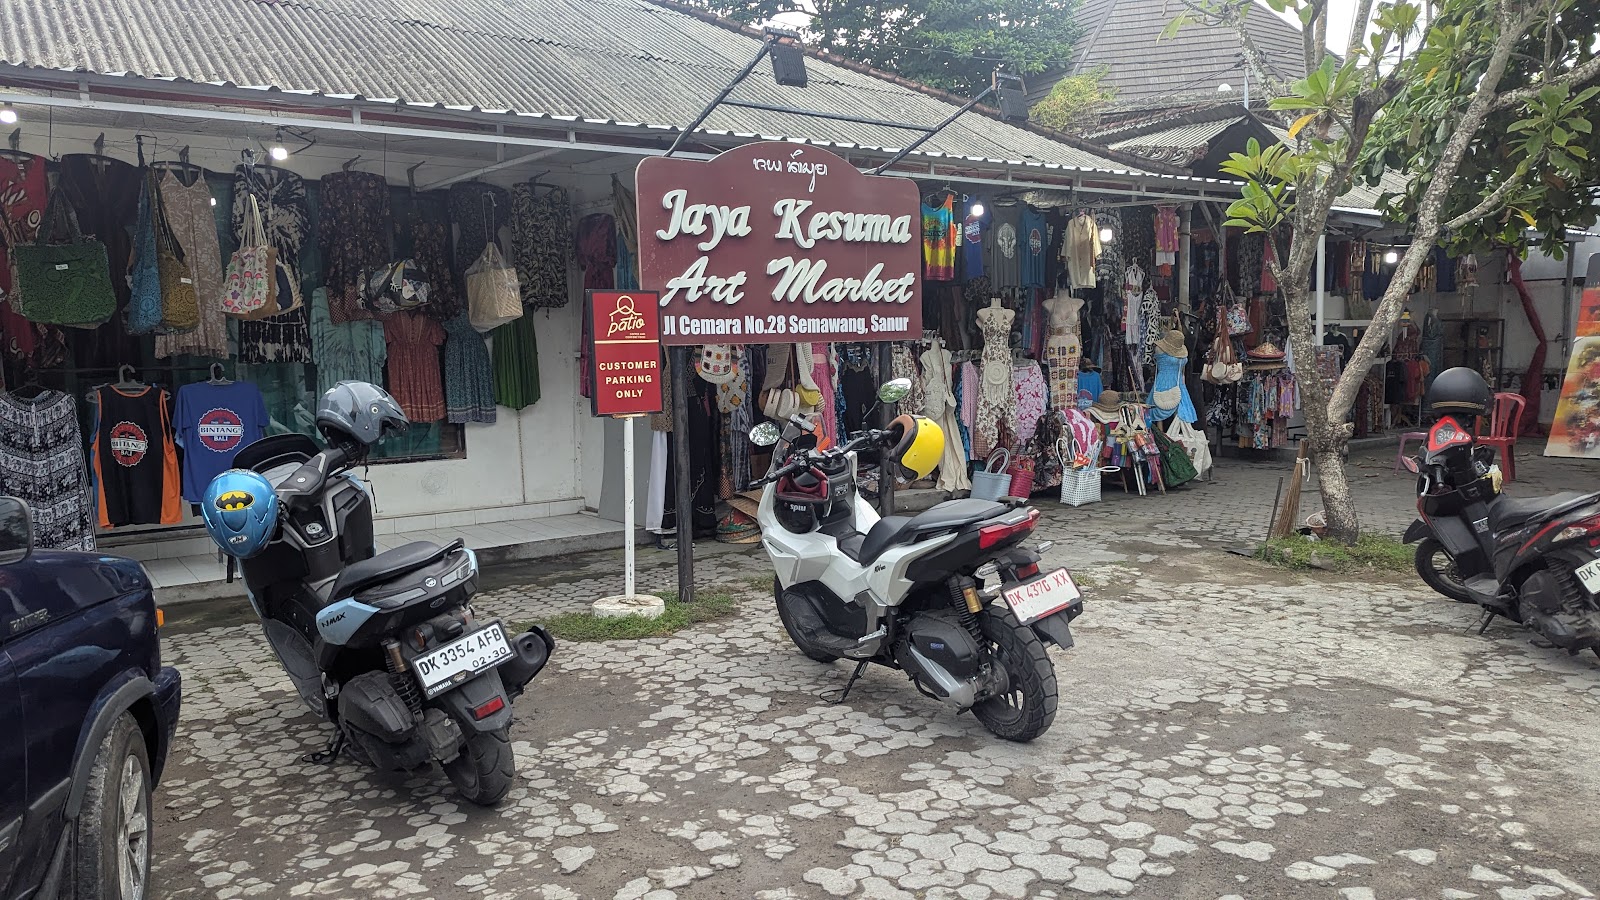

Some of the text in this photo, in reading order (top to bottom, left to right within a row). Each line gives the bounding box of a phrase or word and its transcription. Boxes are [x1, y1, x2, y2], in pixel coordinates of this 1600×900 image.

[656, 189, 751, 251] Jaya
[773, 199, 912, 249] Kesuma
[659, 256, 915, 307] Art Market
[607, 314, 645, 337] patio
[679, 315, 741, 335] Cemara
[744, 315, 786, 334] No.28
[789, 316, 868, 334] Semawang,
[870, 314, 909, 332] Sanur
[599, 360, 657, 371] CUSTOMER
[605, 375, 652, 385] PARKING
[616, 389, 643, 399] ONLY
[1579, 566, 1596, 581] DK
[1007, 591, 1024, 606] DK
[1052, 572, 1069, 588] XX
[418, 656, 440, 676] DK
[440, 640, 475, 666] 3354
[477, 628, 502, 650] AFB
[432, 680, 453, 693] YAMAHA
